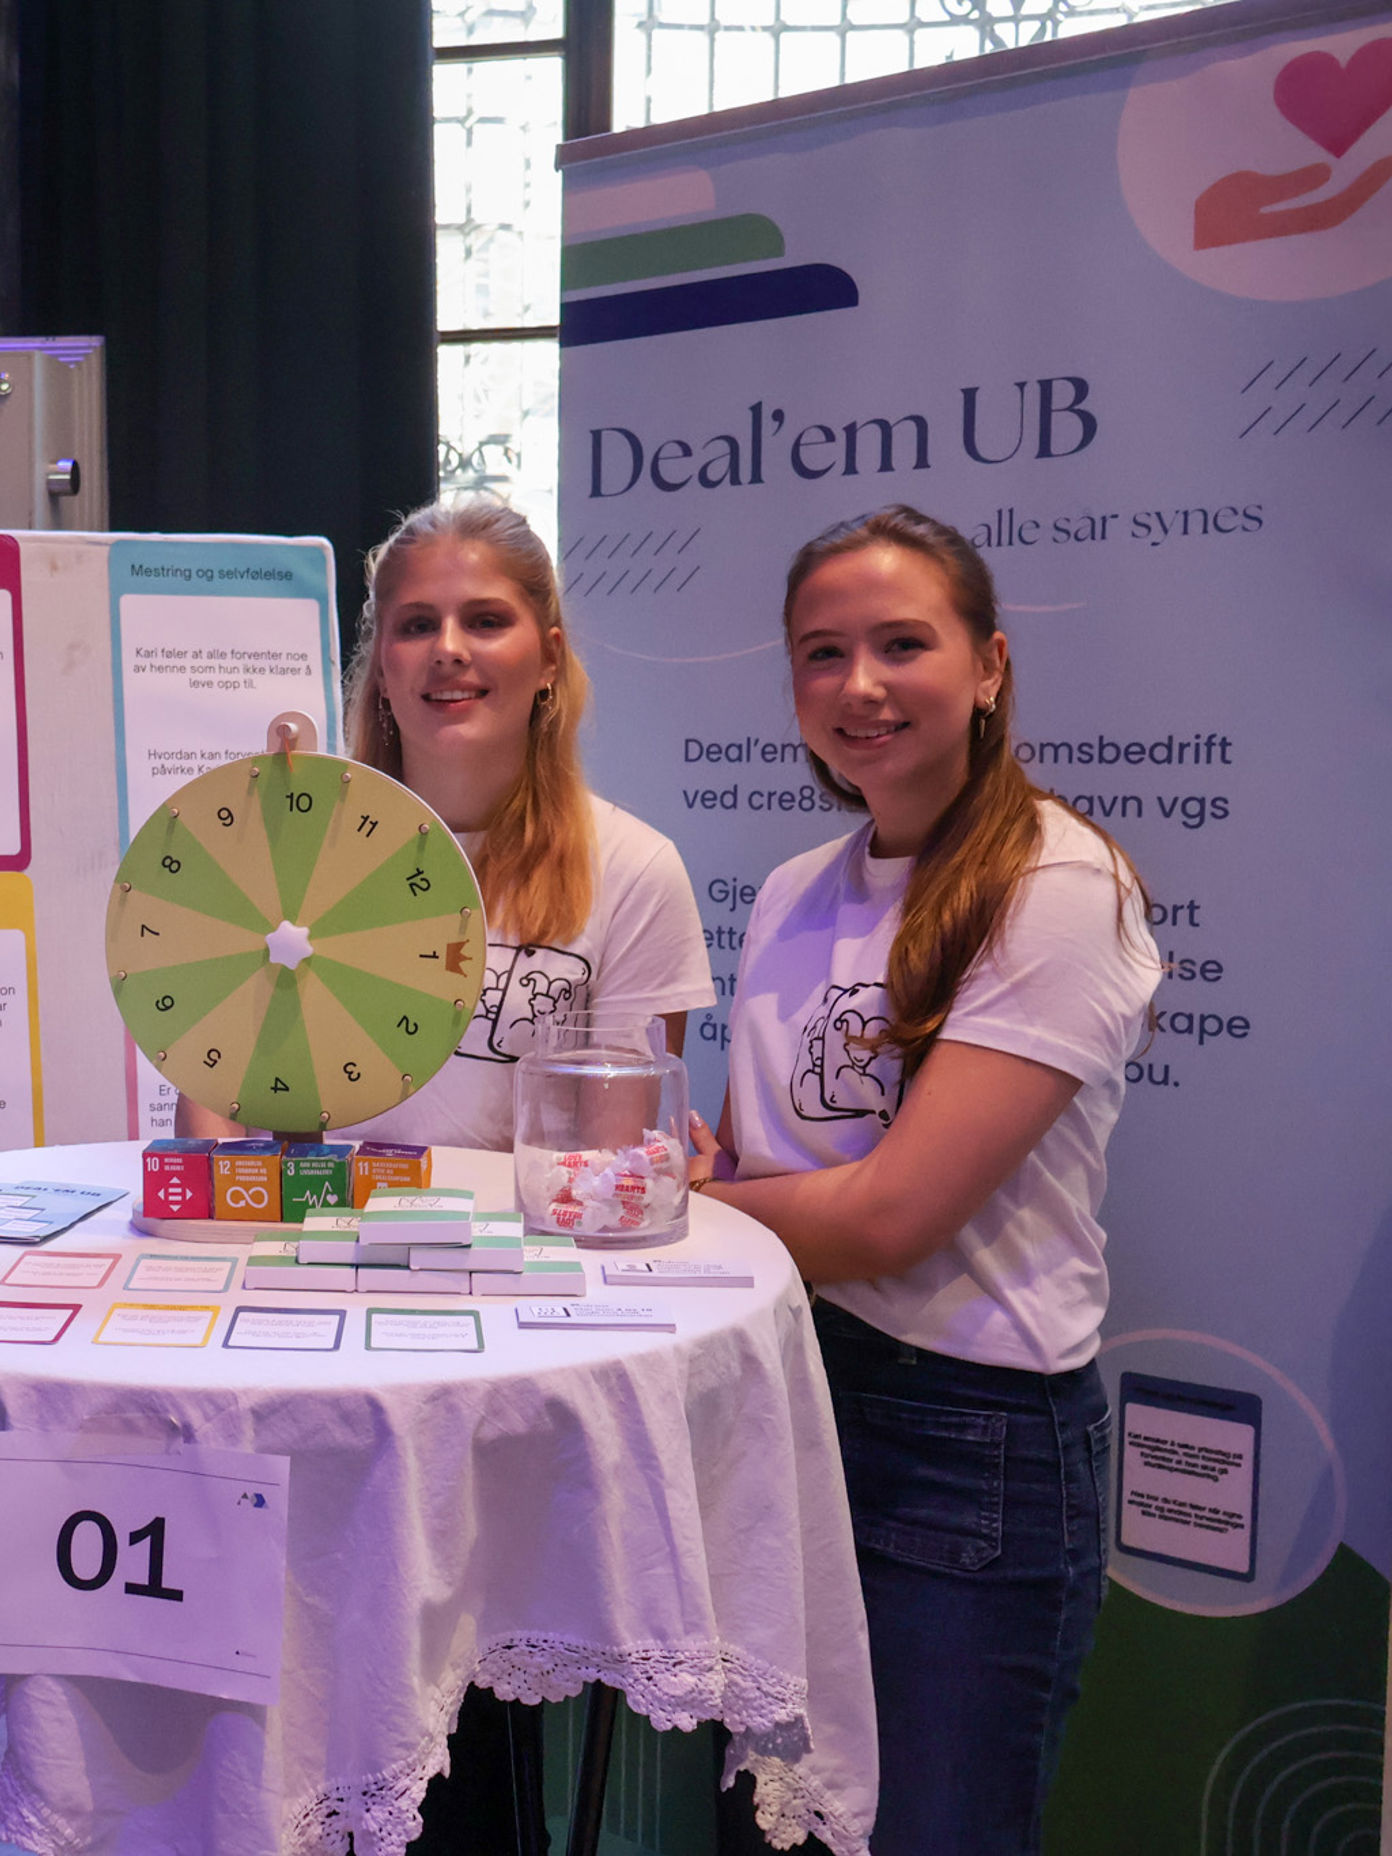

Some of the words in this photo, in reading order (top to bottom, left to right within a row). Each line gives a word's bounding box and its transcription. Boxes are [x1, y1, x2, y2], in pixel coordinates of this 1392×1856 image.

[589, 400, 931, 498] Deal'em
[960, 376, 1098, 465] UB
[970, 507, 1040, 548] alle
[1130, 503, 1264, 546] synes
[130, 564, 192, 581] Mestring
[196, 568, 213, 582] og
[218, 567, 293, 581] selvfølelse
[135, 647, 158, 659] Kari
[161, 647, 188, 659] føler
[191, 649, 203, 660] at
[206, 648, 227, 660] alle
[230, 649, 282, 661] forventer
[286, 651, 308, 661] noe
[133, 665, 147, 673] av
[149, 663, 186, 674] henne
[190, 665, 216, 674] som
[218, 664, 240, 674] hun
[243, 664, 266, 675] ikke
[269, 664, 301, 676] klarer
[305, 665, 312, 676] å
[189, 678, 214, 688] leve
[217, 680, 240, 691] opp
[148, 749, 196, 760] Hvordan
[200, 750, 221, 760] kan
[684, 737, 809, 763] Deal'em
[1014, 733, 1232, 765] omsbedrift
[151, 764, 194, 777] påvirke
[286, 792, 312, 814] 10
[683, 784, 738, 809] ved
[748, 785, 842, 812] cre8s
[1049, 788, 1143, 818] avn
[1157, 795, 1230, 830] vgs
[217, 807, 235, 827] 9
[356, 814, 379, 838] 11
[161, 855, 181, 874] 8
[406, 867, 431, 897] 12
[708, 877, 761, 912] Gje
[139, 923, 160, 938] 7
[396, 1015, 420, 1036] 2
[203, 1047, 222, 1068] 5
[343, 1062, 361, 1082] 3
[159, 1085, 171, 1096] Er
[270, 1077, 290, 1094] 4
[150, 1116, 173, 1127] han
[146, 1156, 160, 1172] 10
[218, 1160, 231, 1175] 12
[287, 1161, 295, 1176] 3
[358, 1161, 370, 1176] 11
[56, 1509, 184, 1602] 01
